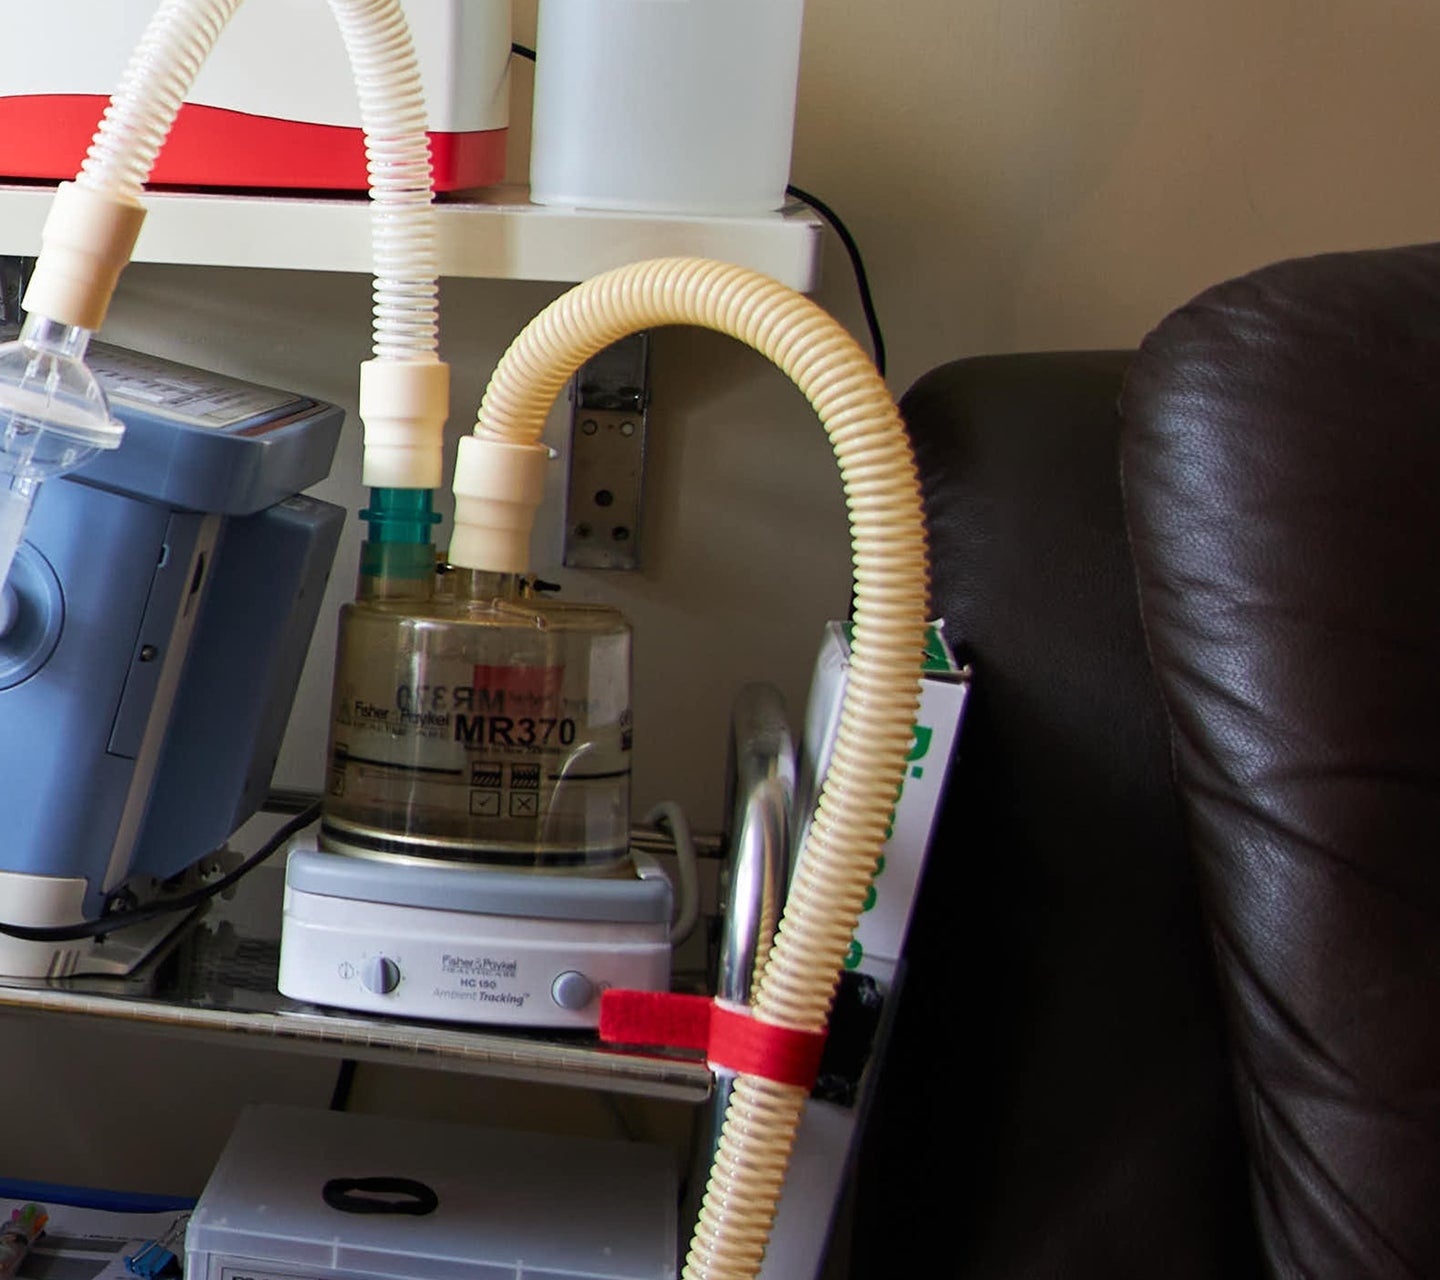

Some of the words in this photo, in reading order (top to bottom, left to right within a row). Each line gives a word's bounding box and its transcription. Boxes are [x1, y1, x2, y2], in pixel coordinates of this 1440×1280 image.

[354, 700, 390, 720] Fisher
[454, 712, 576, 747] MR370
[442, 955, 474, 969] Fisher
[483, 958, 518, 972] Paykel
[433, 987, 478, 1001] Ambient
